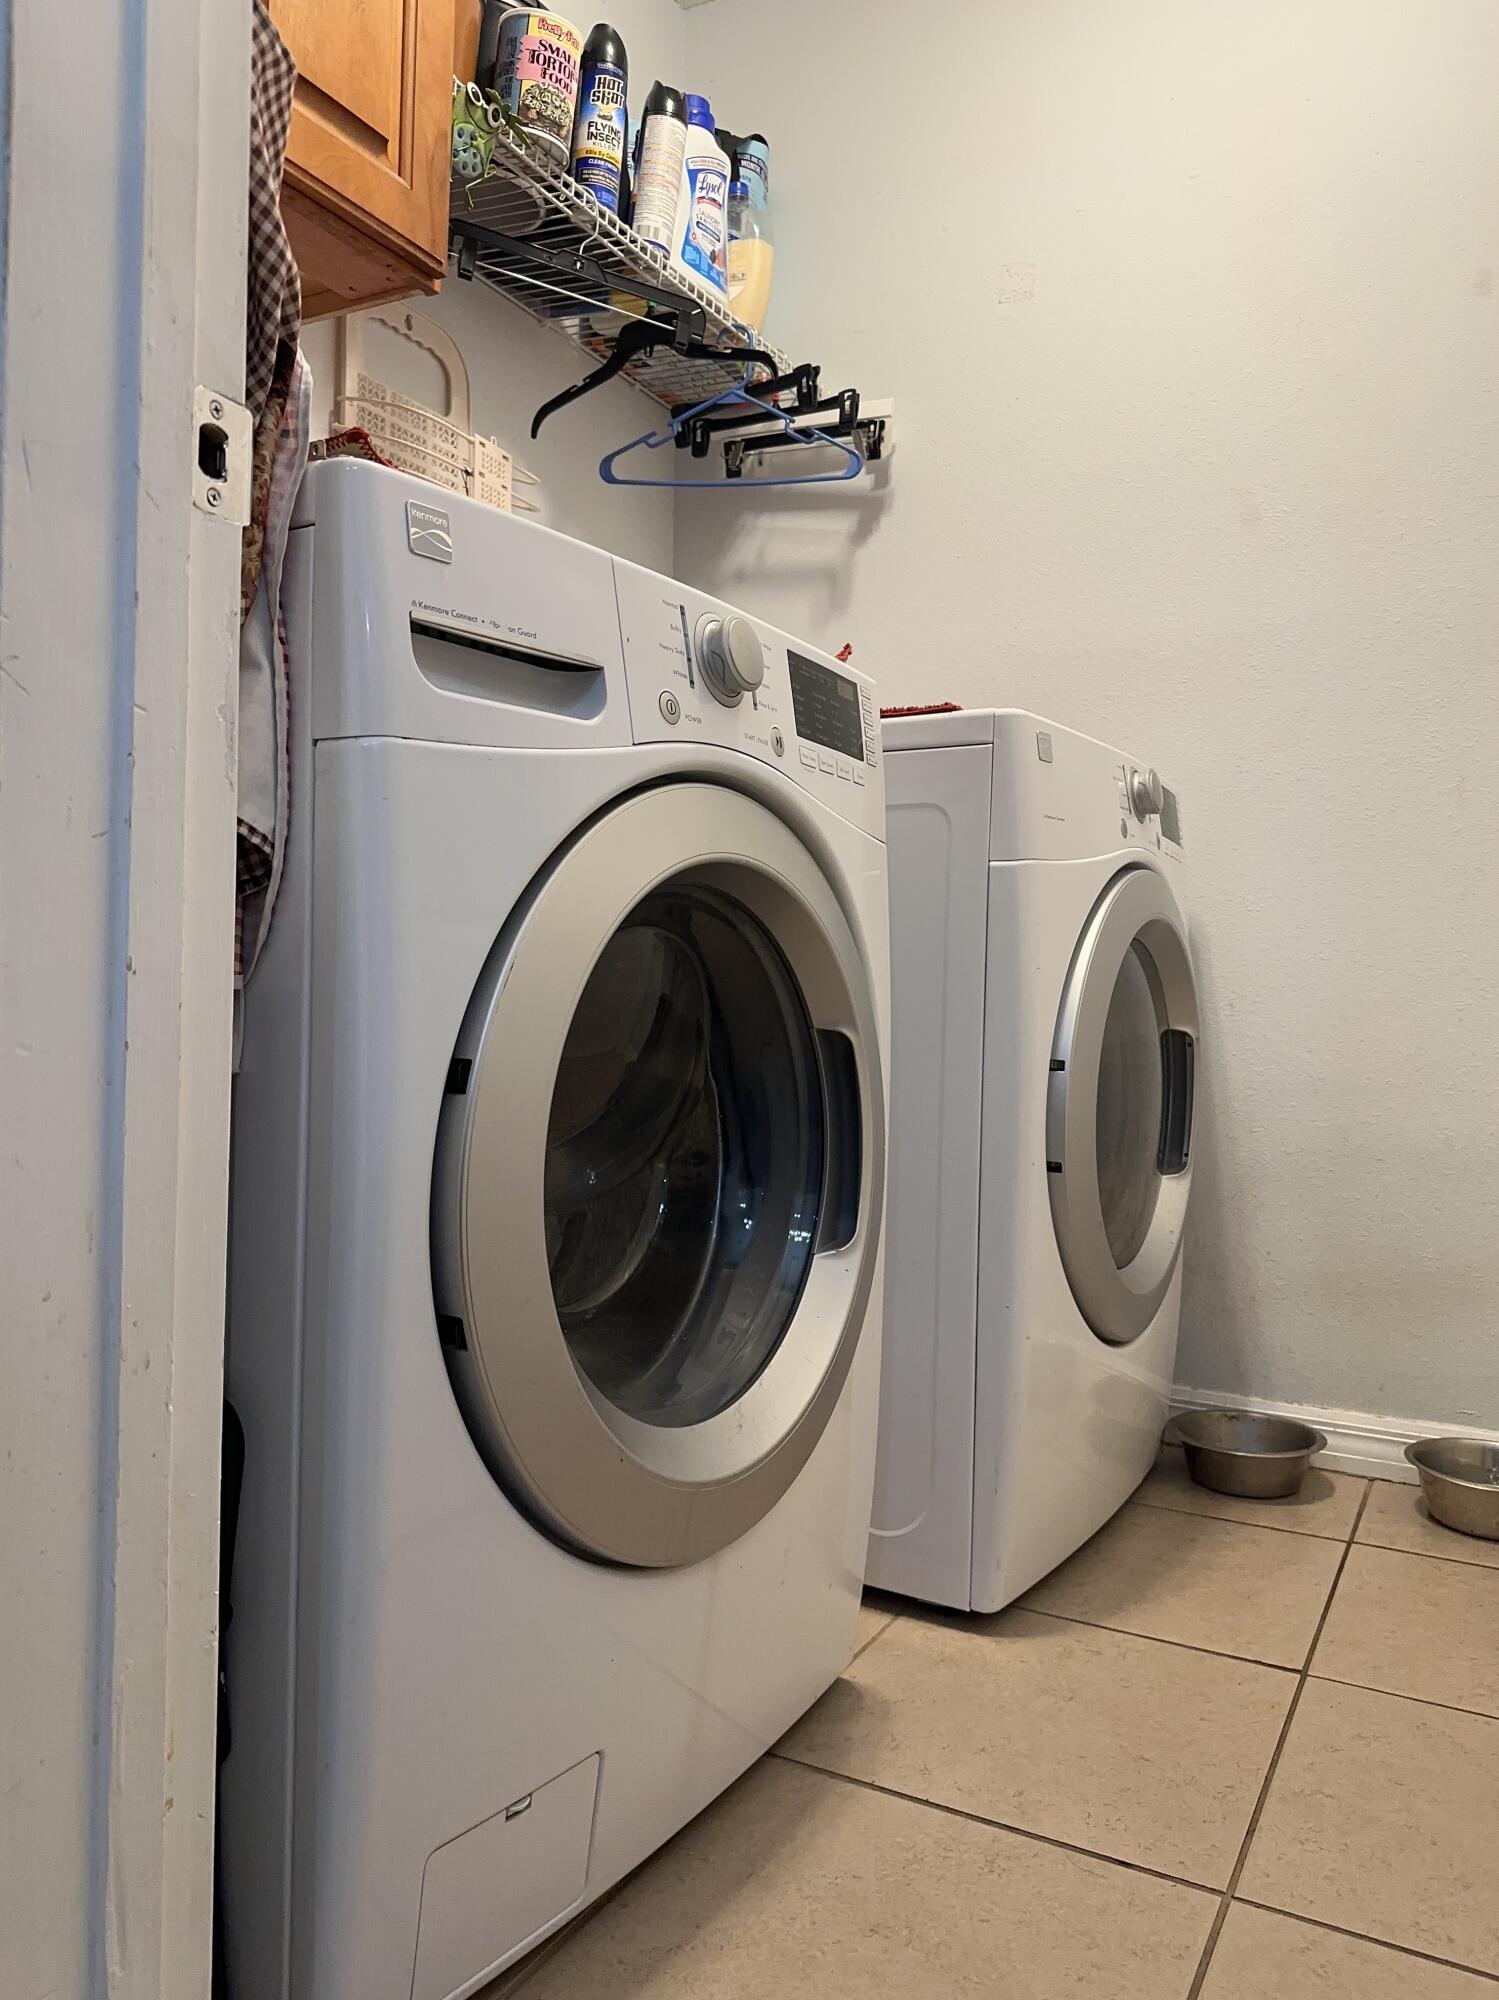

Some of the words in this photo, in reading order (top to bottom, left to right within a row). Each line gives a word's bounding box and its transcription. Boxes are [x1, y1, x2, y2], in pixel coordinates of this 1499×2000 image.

[538, 18, 566, 41] Pretty
[538, 39, 577, 71] SMALL
[540, 67, 572, 95] FOOD
[595, 75, 623, 93] HOT
[591, 90, 624, 107] SHOT
[587, 121, 621, 140] FLYING
[587, 131, 621, 150] INSECT
[592, 141, 616, 151] KILLER
[698, 174, 721, 197] Lysol
[411, 508, 448, 527] Kenmore
[418, 601, 450, 616] Kenmore
[451, 609, 478, 623] Connect
[517, 628, 537, 639] Guard
[685, 714, 702, 724] POWER
